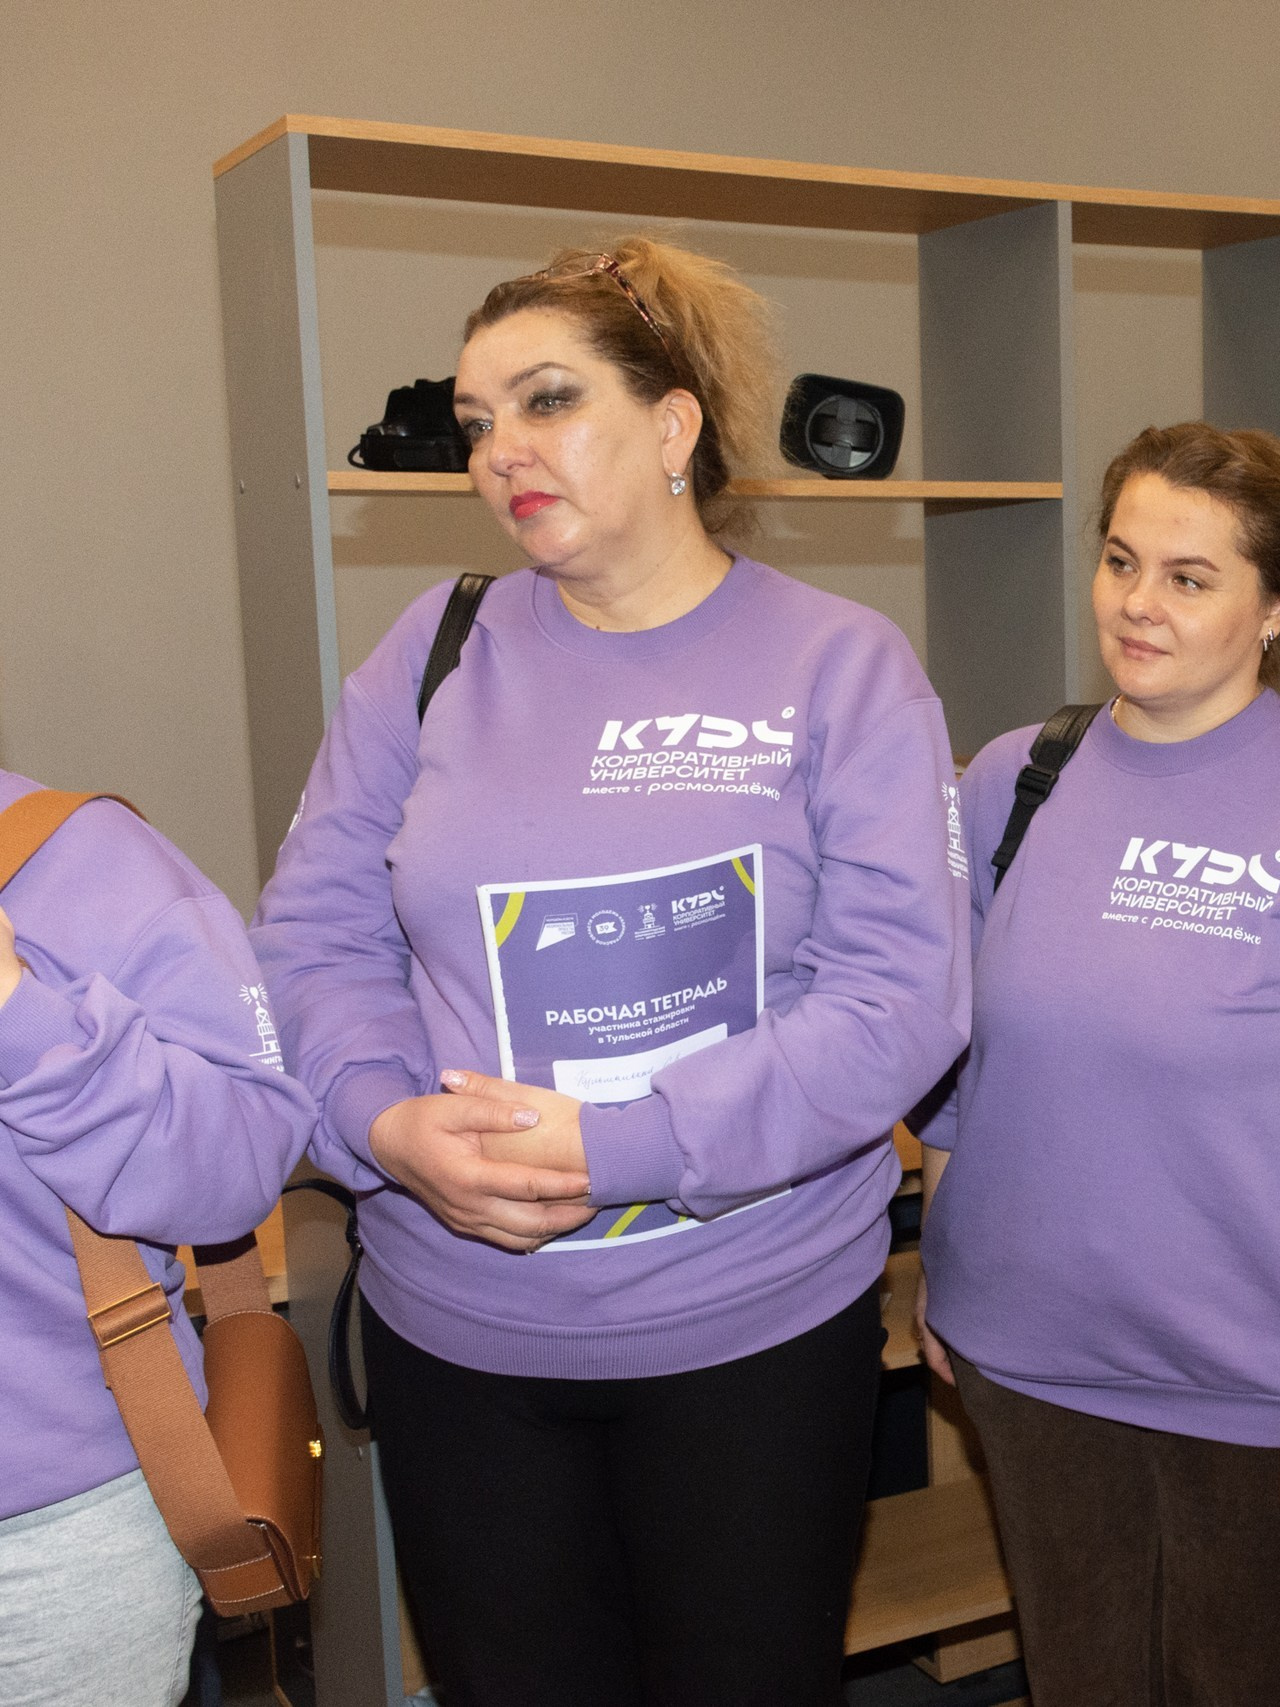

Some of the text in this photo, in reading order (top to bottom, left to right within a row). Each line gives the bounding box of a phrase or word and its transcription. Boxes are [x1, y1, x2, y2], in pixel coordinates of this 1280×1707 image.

[591, 747, 792, 768] КОРПОРАТИВНЫЙ
[589, 765, 750, 781] УНИВЕРСИТЕТ
[582, 782, 781, 802] вместе с росмолодёжь
[1109, 891, 1237, 921] УНИВЕРСИТЕТ
[1112, 876, 1274, 913] КОРПОРАТИВНЫЙ
[1102, 911, 1262, 945] вместе с росмолодёжь
[545, 977, 728, 1026] РАБОЧАЯ ТЕТРАДЬ
[588, 1004, 696, 1036] участника стажировки
[605, 1029, 653, 1045] Тульской
[655, 1017, 690, 1034] области
